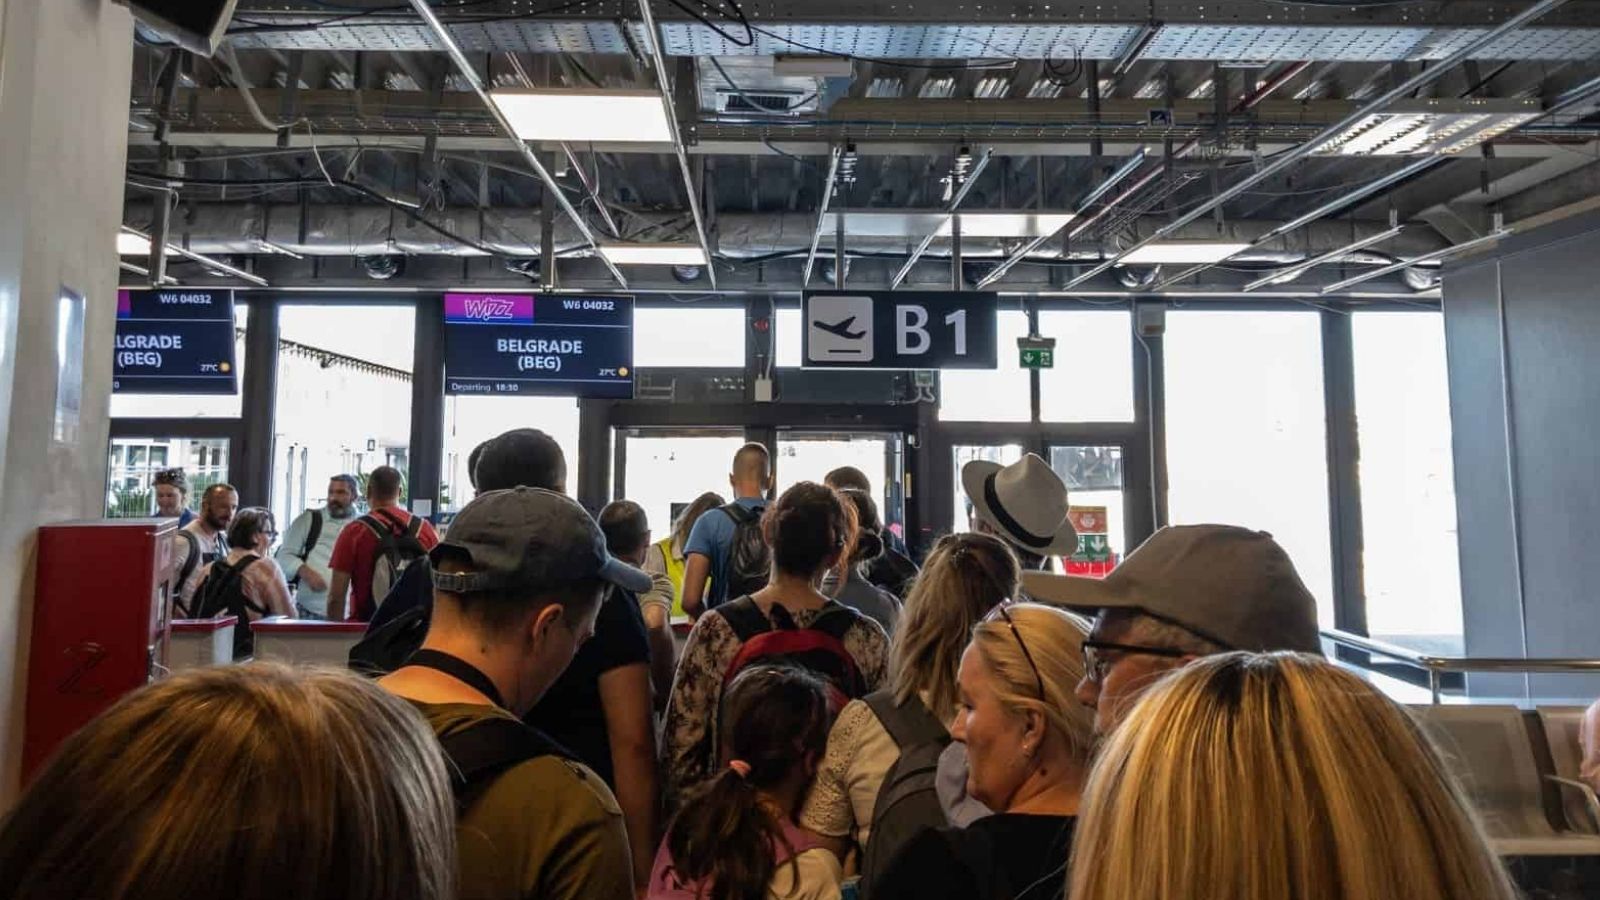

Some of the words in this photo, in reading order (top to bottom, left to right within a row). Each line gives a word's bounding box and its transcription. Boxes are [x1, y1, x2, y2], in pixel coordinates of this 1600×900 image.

[160, 294, 177, 304] W6
[180, 294, 211, 304] 04032
[563, 300, 581, 310] W6
[583, 301, 615, 311] 04032
[896, 304, 931, 355] B
[945, 309, 967, 355] 1
[114, 335, 182, 349] LGRADE
[497, 338, 583, 354] BELGRADE
[118, 352, 162, 367] (BEG)
[518, 356, 562, 371] (BEG)
[451, 383, 491, 392] Departing
